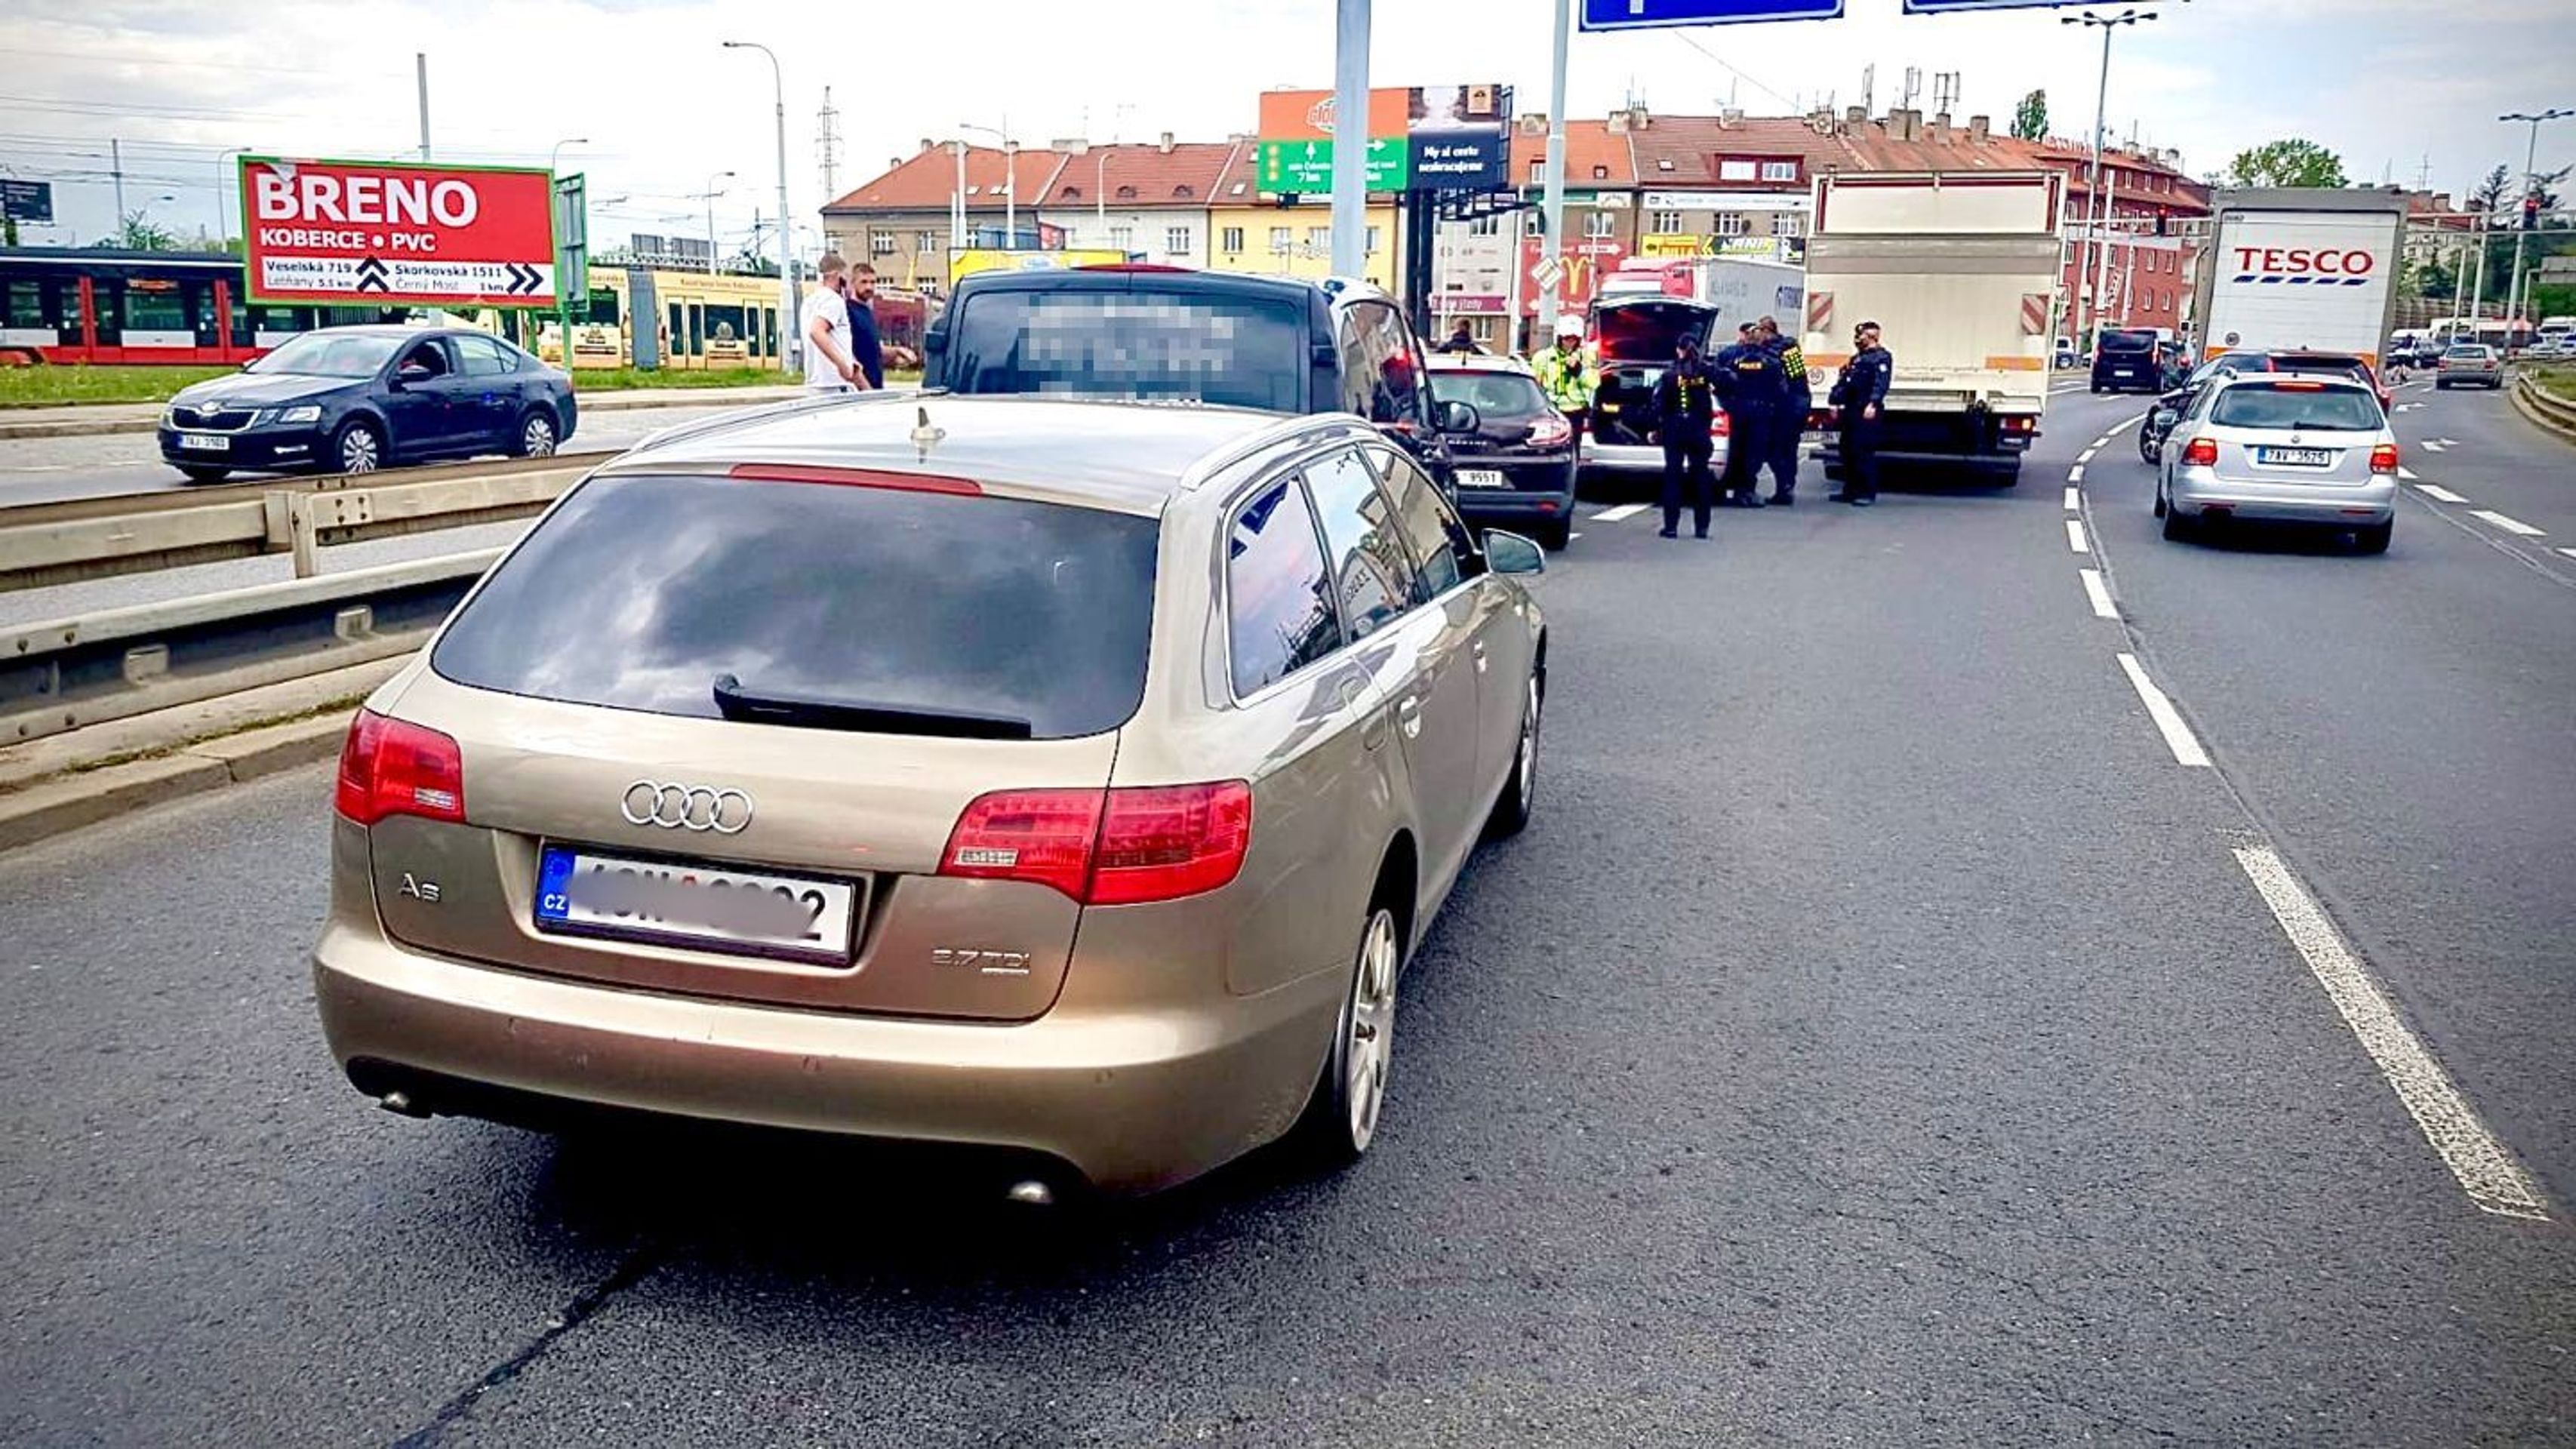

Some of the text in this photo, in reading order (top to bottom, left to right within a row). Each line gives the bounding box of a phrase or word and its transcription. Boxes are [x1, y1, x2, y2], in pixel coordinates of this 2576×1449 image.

[256, 172, 479, 228] BRENO
[260, 229, 436, 252] KOBERCE PVC
[266, 261, 352, 273] Veselská 719
[2234, 248, 2374, 275] TESCO
[395, 265, 502, 278] Skorkovská 1511
[337, 278, 353, 288] km
[488, 282, 504, 291] km
[398, 872, 440, 901] A6
[543, 893, 567, 911] CZ
